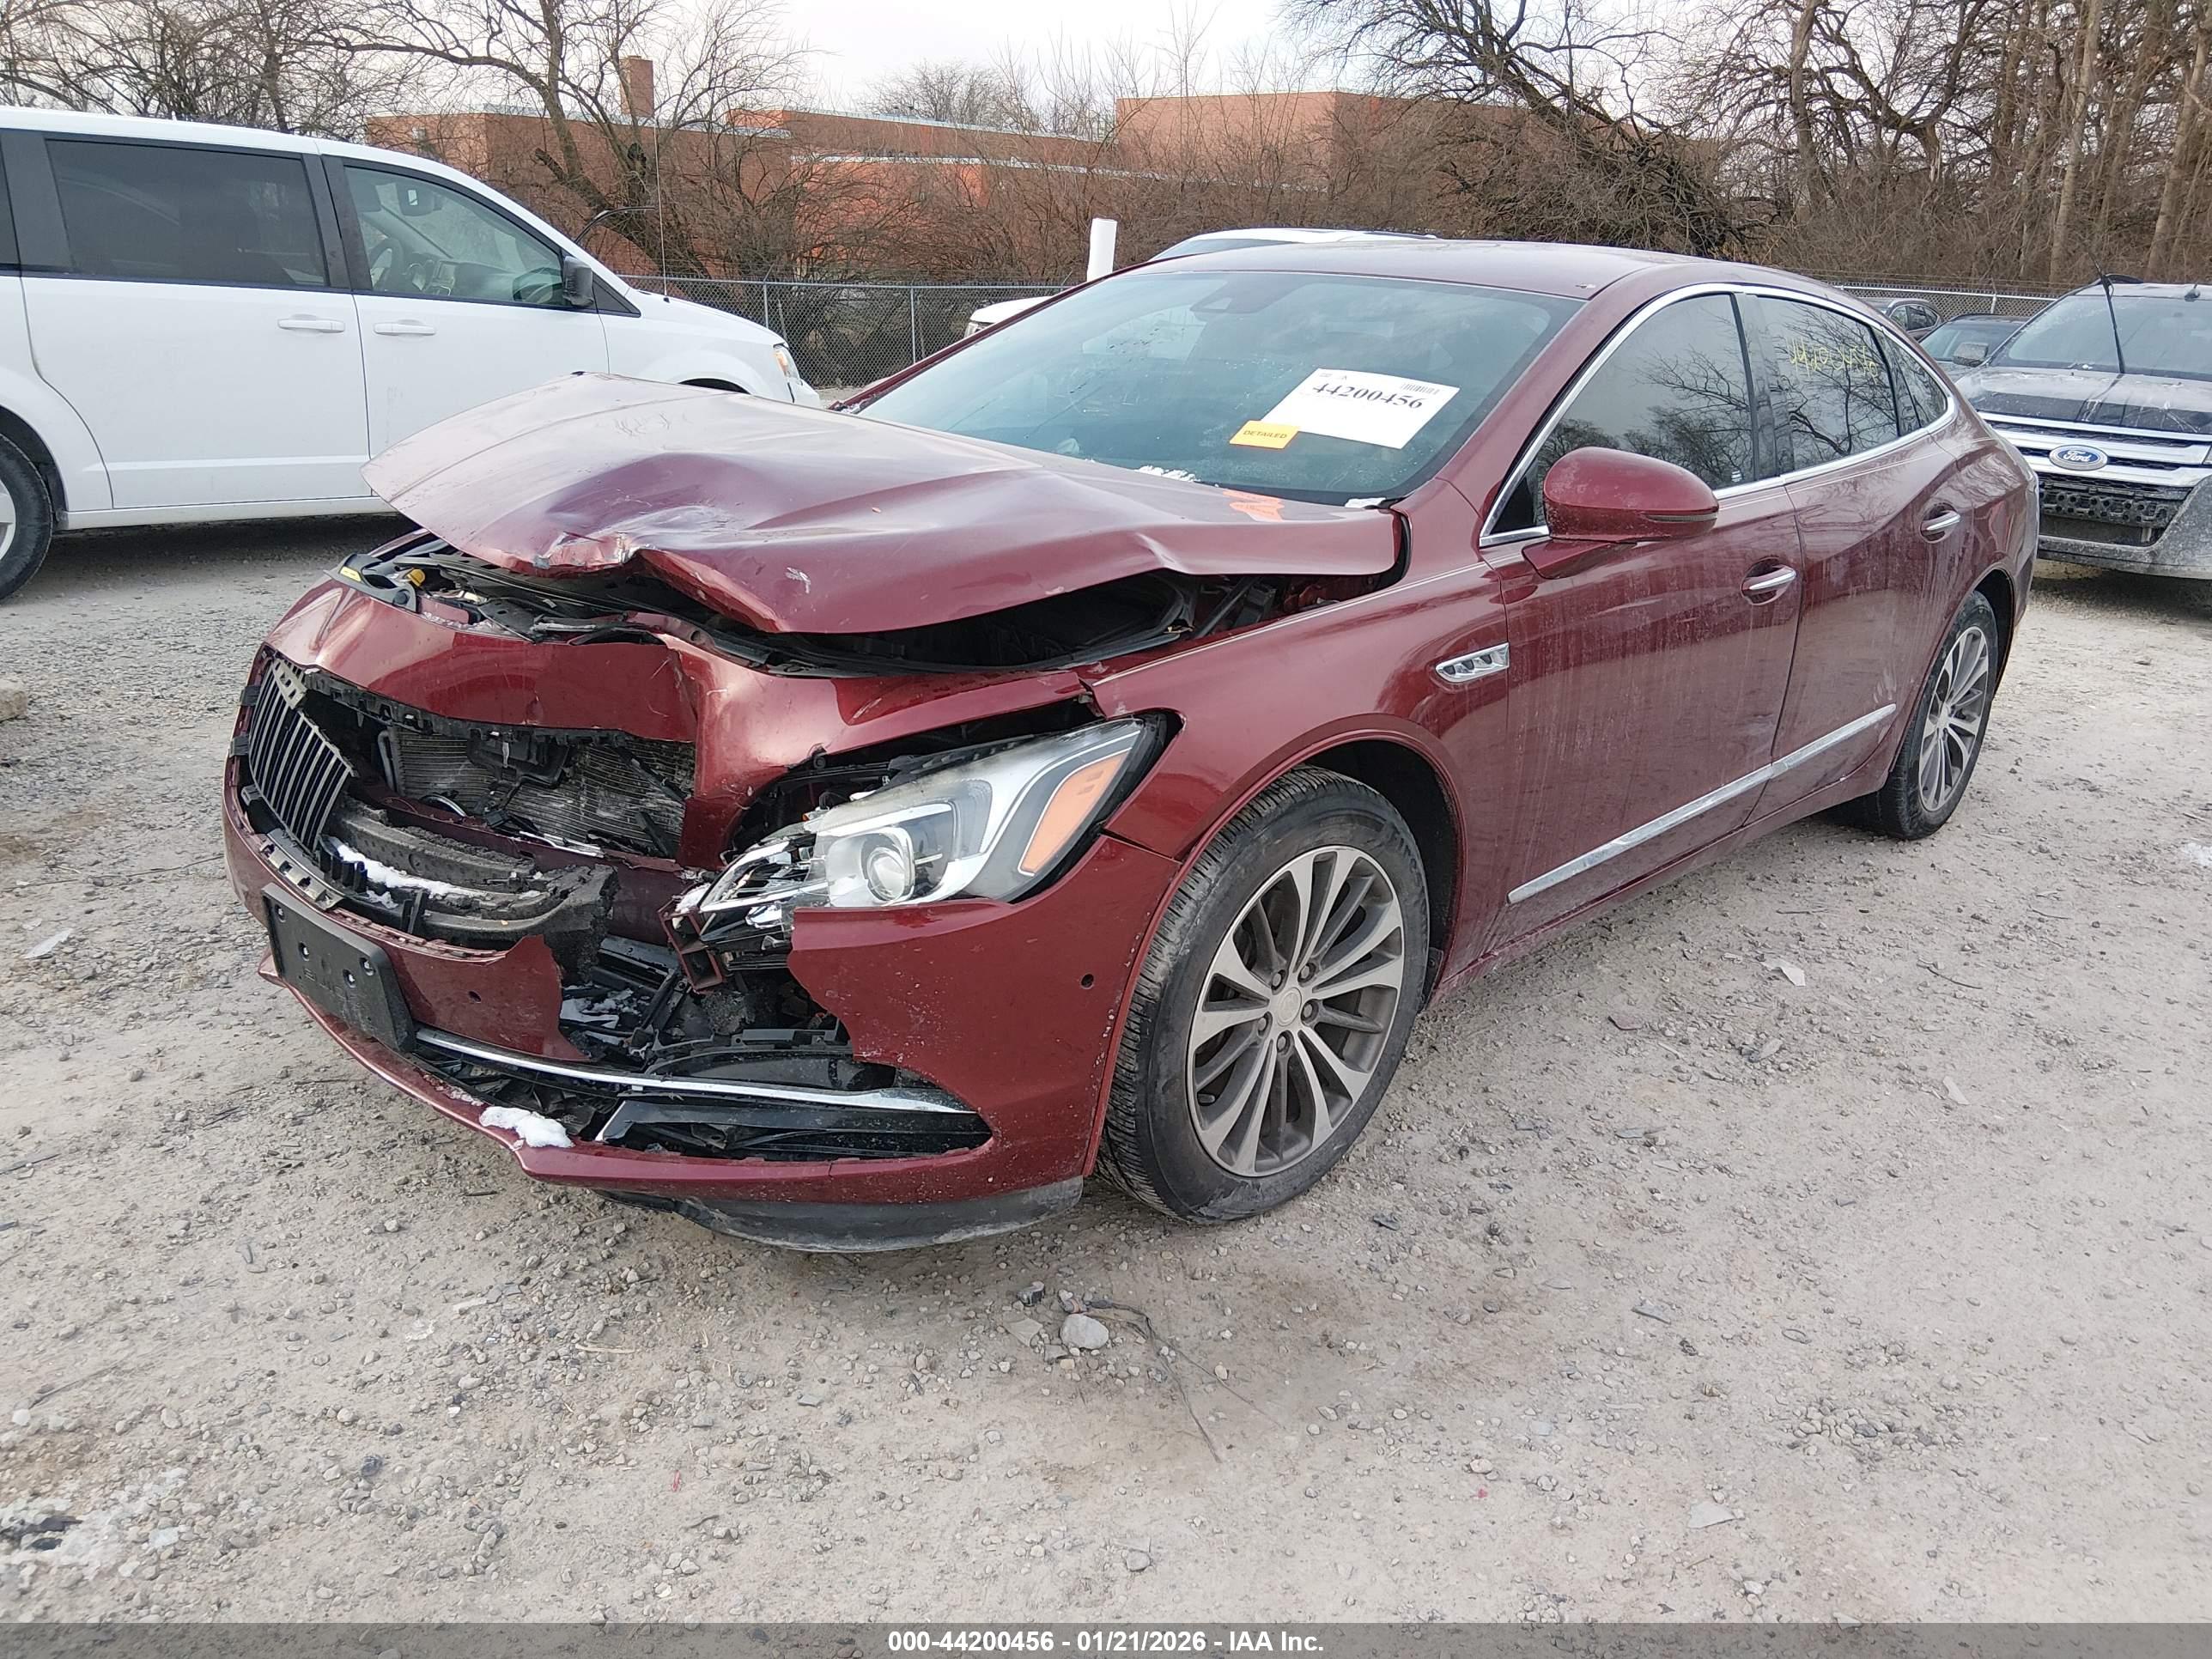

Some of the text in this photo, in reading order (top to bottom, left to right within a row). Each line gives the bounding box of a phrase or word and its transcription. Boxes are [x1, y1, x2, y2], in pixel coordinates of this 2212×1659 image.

[1313, 383, 1426, 409] 44200456
[1243, 430, 1288, 439] DETAILED
[2063, 450, 2092, 462] Ford
